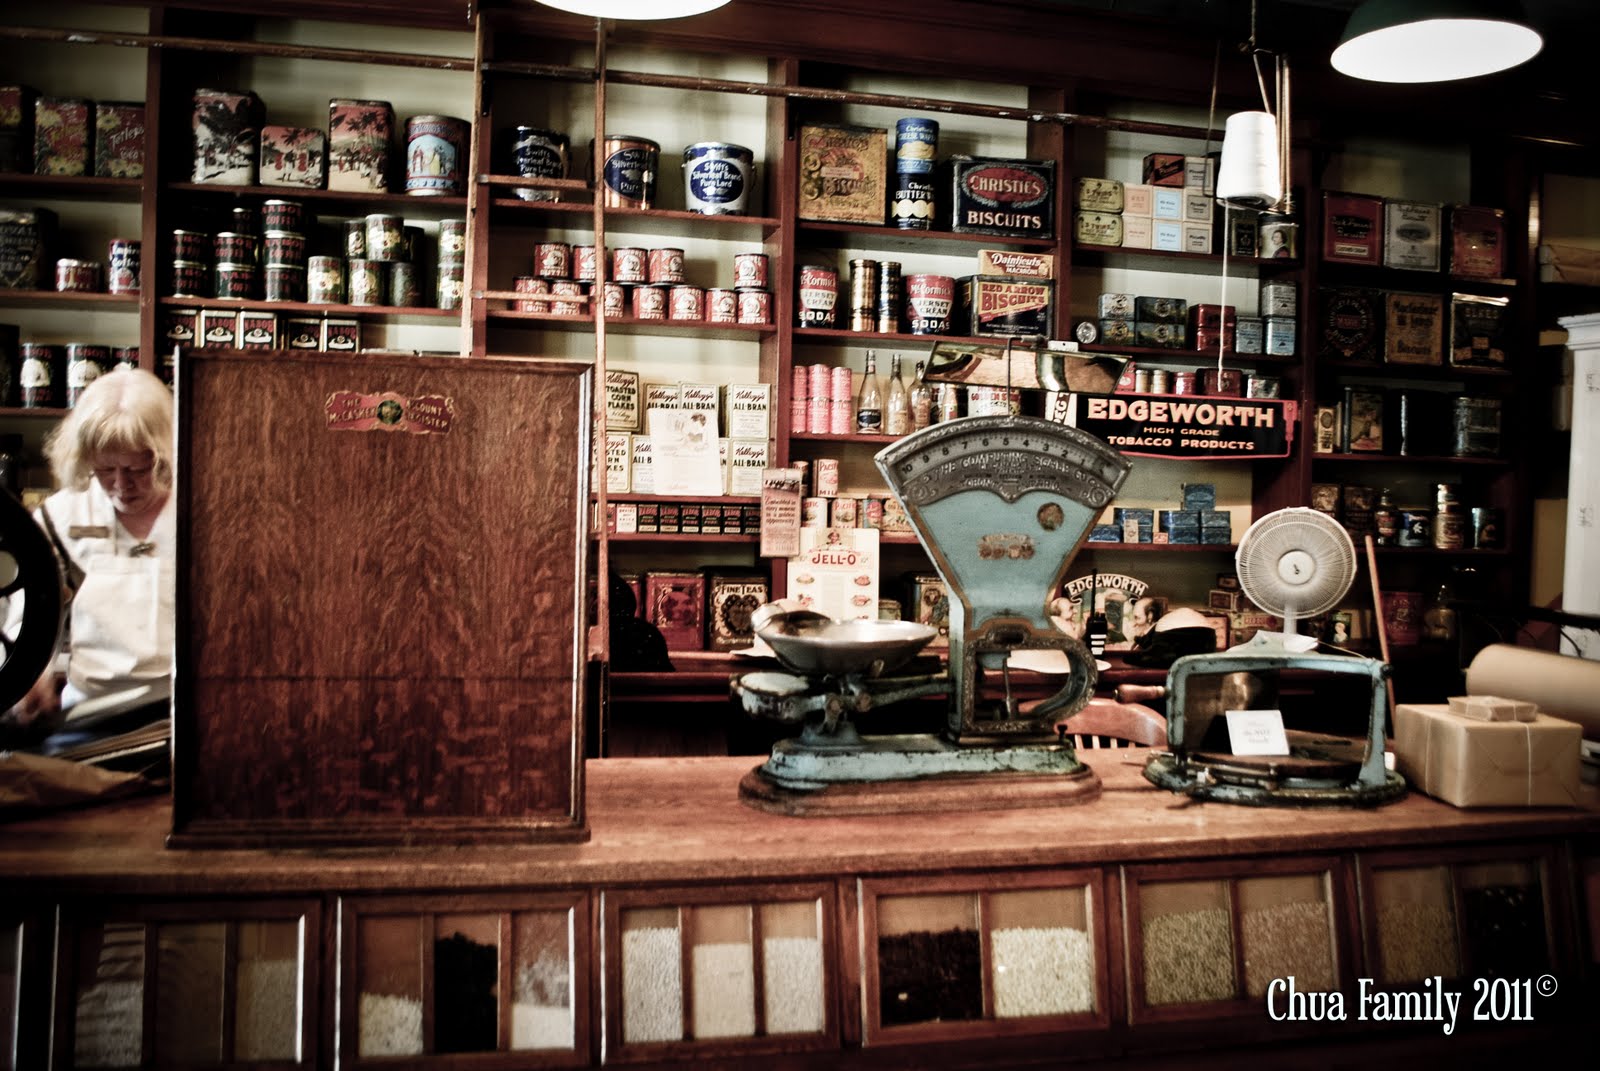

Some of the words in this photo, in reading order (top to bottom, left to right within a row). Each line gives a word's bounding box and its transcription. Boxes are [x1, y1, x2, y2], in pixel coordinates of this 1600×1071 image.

[967, 210, 1042, 229] BISCUITS
[982, 283, 1003, 292] RED
[1005, 286, 1045, 295] ARROW
[981, 293, 1045, 311] BISCUITS
[798, 311, 835, 322] SODAS
[911, 319, 950, 329] SODAS
[607, 372, 636, 388] Kellogg's
[606, 385, 636, 395] TOASTED
[649, 389, 679, 402] Kellogg's
[685, 389, 715, 402] Kellogg's
[735, 389, 765, 402] Kellogg's
[608, 401, 635, 410] FLAKES
[1087, 398, 1275, 428] EDGEWORTH
[1180, 428, 1220, 436] GRADE
[1107, 436, 1173, 447] TOBACCO
[1180, 439, 1255, 450] PRODUCTS
[735, 446, 765, 459] Kellogg's
[902, 463, 913, 474] 10
[923, 455, 930, 463] 9
[942, 447, 949, 456] 8
[961, 441, 968, 449] 7
[982, 437, 989, 446] 6
[1003, 437, 1010, 446] 5
[1023, 439, 1030, 447] 4
[1042, 443, 1049, 452] 3
[1062, 449, 1069, 458] 2
[812, 553, 857, 565] JELL-O
[721, 584, 740, 595] FINE
[742, 584, 763, 595] TEAS
[1067, 575, 1146, 596] EDGEWORTH
